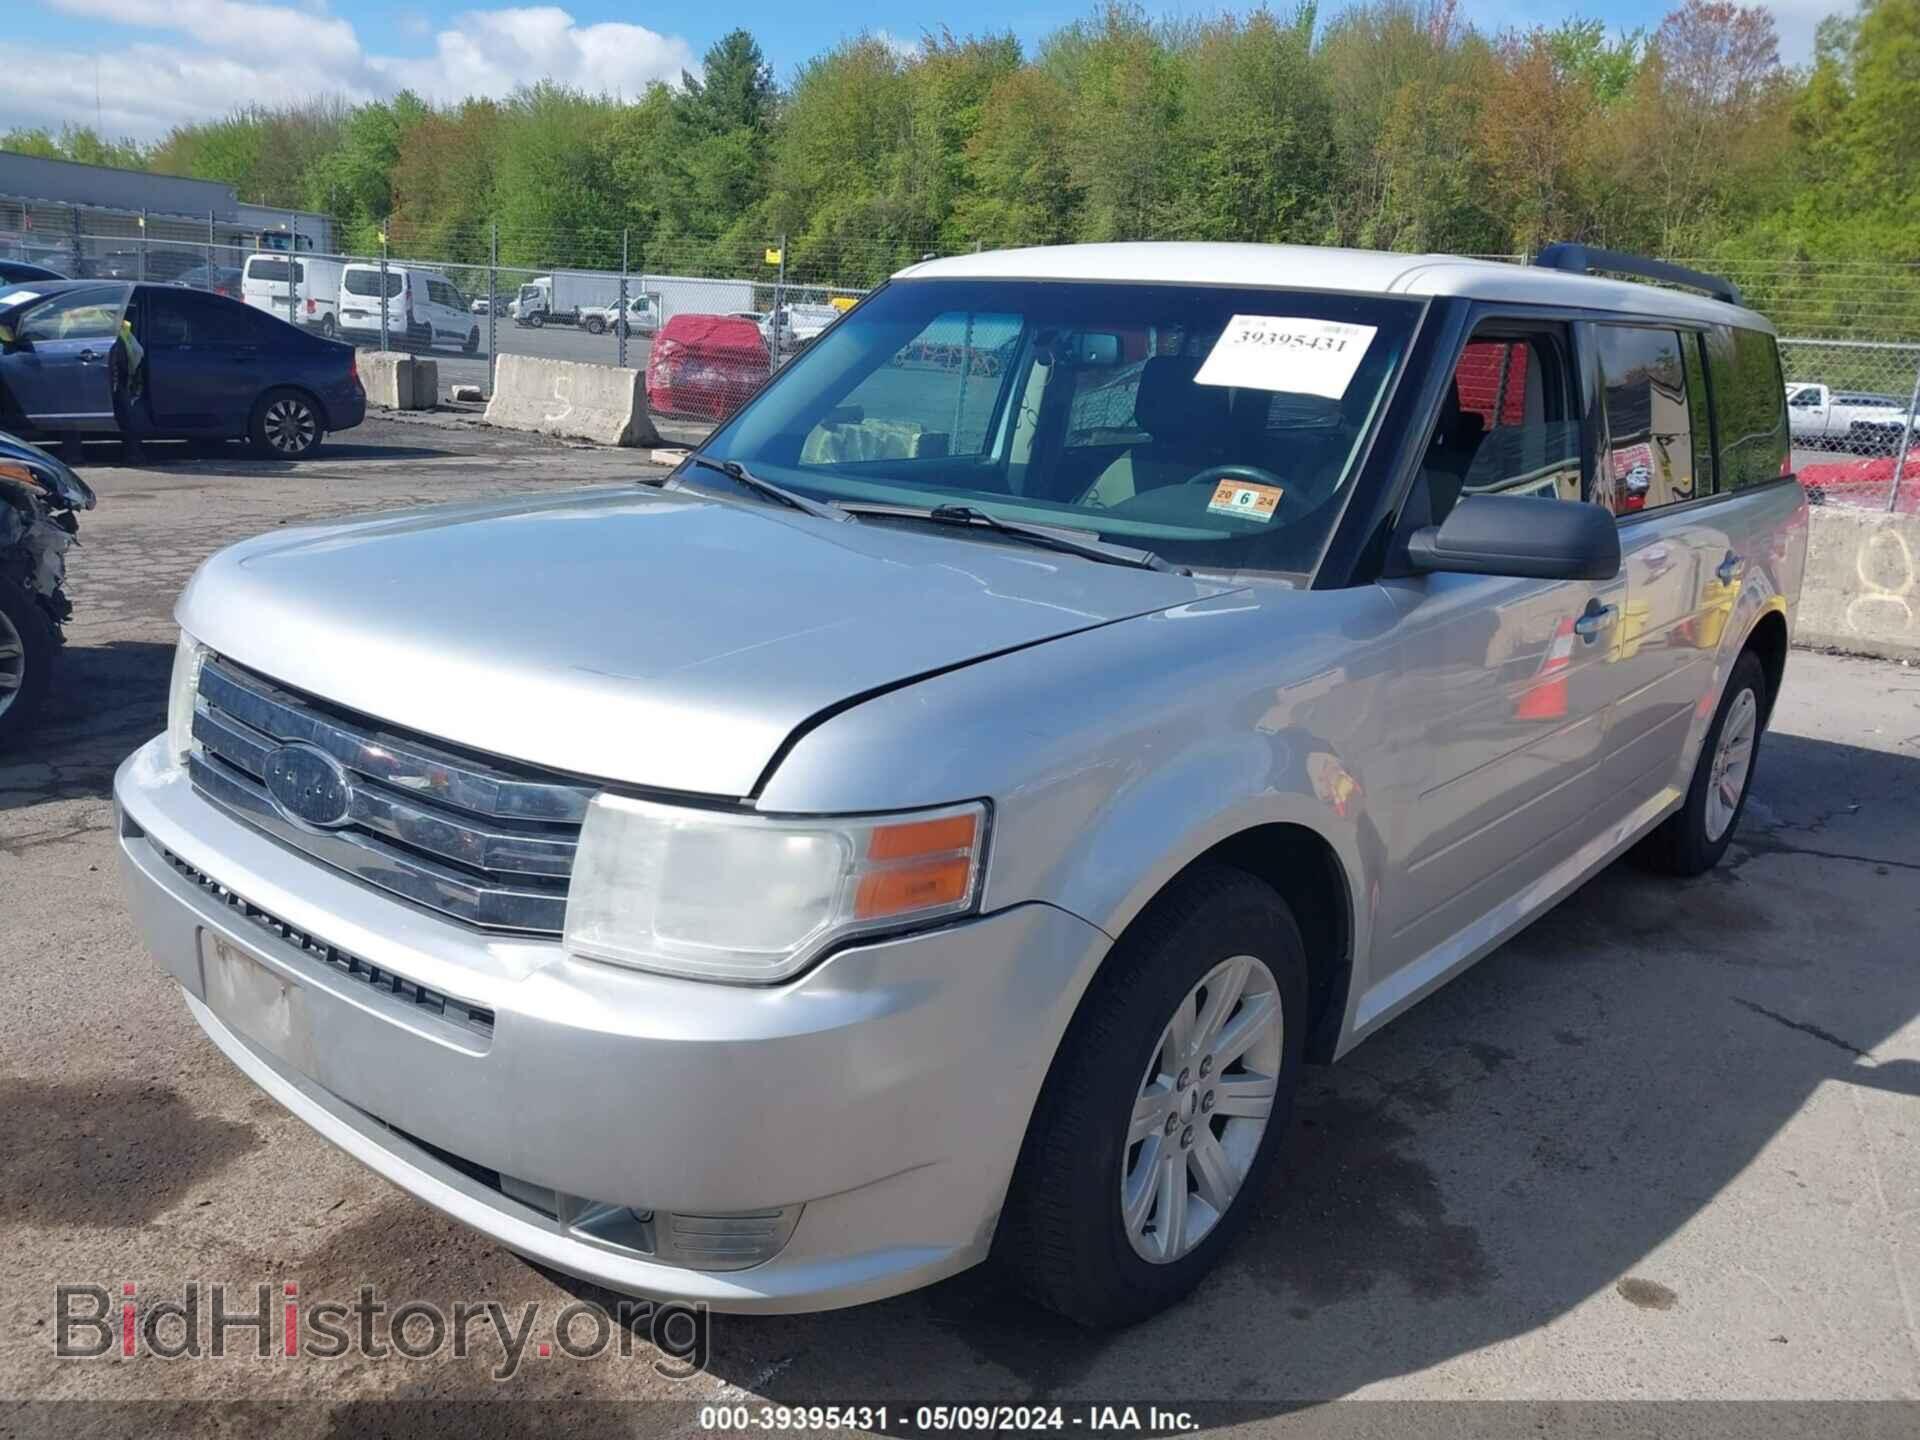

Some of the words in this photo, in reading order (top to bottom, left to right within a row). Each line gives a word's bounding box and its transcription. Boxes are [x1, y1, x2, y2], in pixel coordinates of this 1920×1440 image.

[1234, 331, 1347, 352] 39395431
[1240, 492, 1251, 505] 6
[1258, 497, 1274, 506] 24
